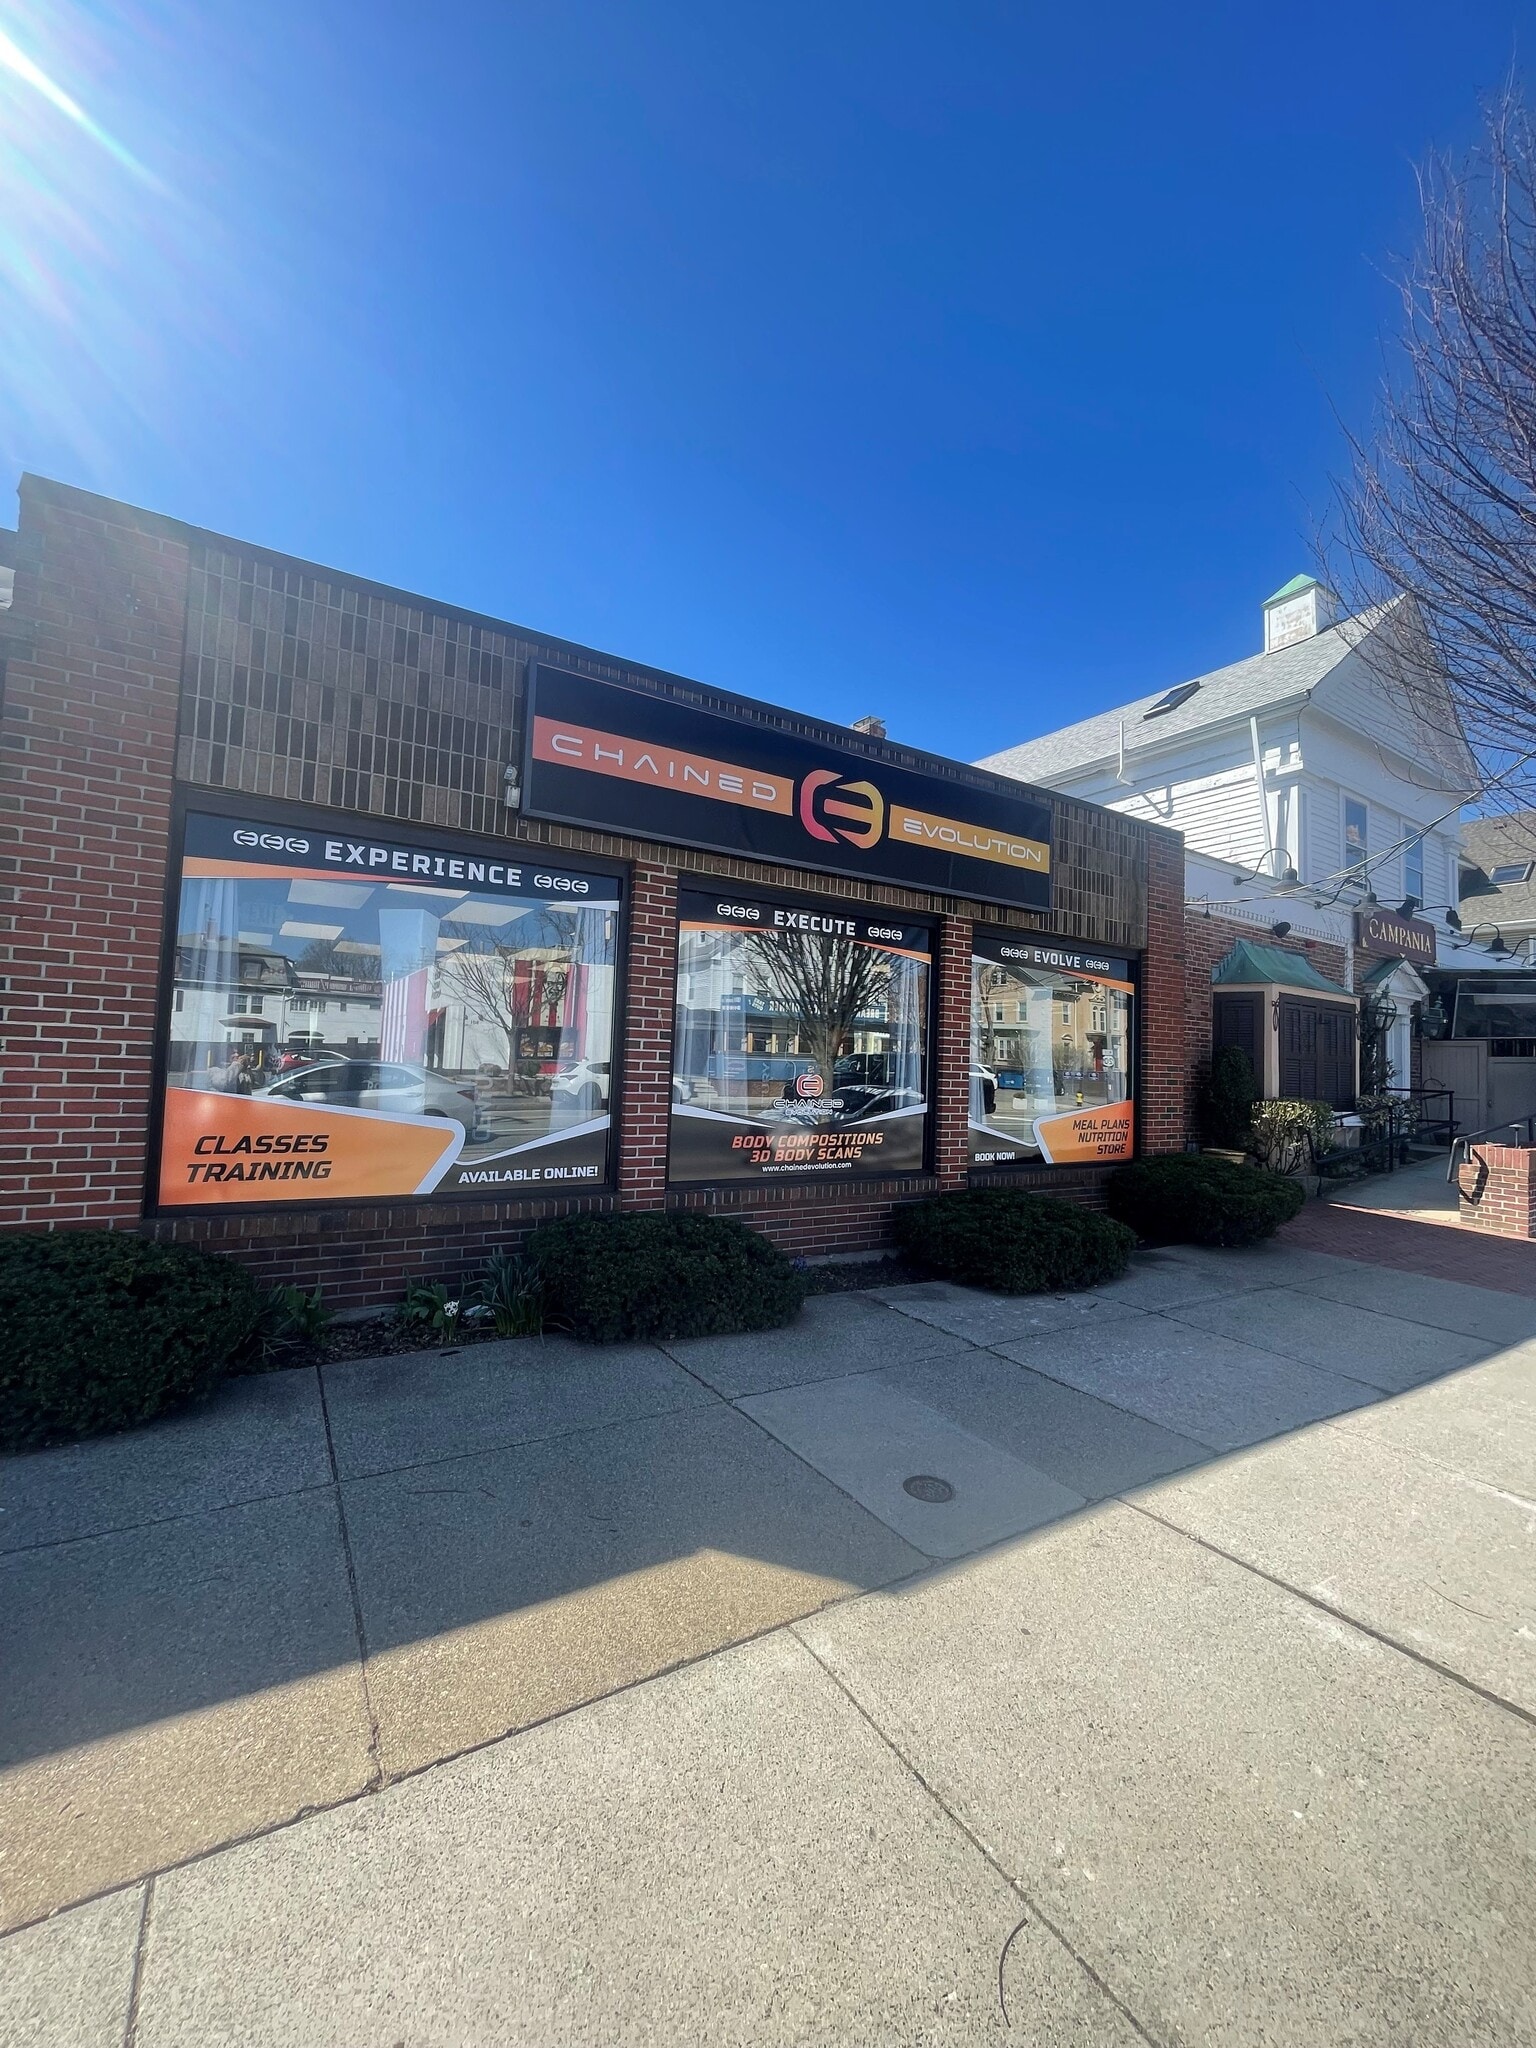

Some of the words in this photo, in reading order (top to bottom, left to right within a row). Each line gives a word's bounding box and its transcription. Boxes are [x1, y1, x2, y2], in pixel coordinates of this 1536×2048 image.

[551, 734, 777, 802] CHAINED
[903, 817, 1042, 863] EVOLUTION
[324, 840, 522, 887] EXPERIENCE
[774, 910, 856, 936] EXECUTE
[1369, 918, 1432, 954] CAMPANIA
[1034, 950, 1081, 968] EVOLVE
[773, 1099, 845, 1109] CHAINED
[1072, 1120, 1099, 1130] MEAL
[1101, 1119, 1130, 1130] PLANS
[194, 1135, 330, 1155] CLASSES
[732, 1135, 775, 1149] BODY
[778, 1133, 884, 1148] COMPOSITIONS
[1078, 1131, 1128, 1143] NUTRITION
[750, 1150, 771, 1163] 3D
[774, 1149, 815, 1162] BODY
[817, 1147, 863, 1160] SCANS
[974, 1152, 995, 1162] BOOK
[996, 1151, 1016, 1161] NOW!
[1097, 1143, 1126, 1155] STORE
[187, 1160, 333, 1183] TRAINING
[458, 1168, 541, 1184] AVAILABLE
[544, 1166, 599, 1179] ONLINE!
[762, 1162, 852, 1172] www.chainedevolution.com
